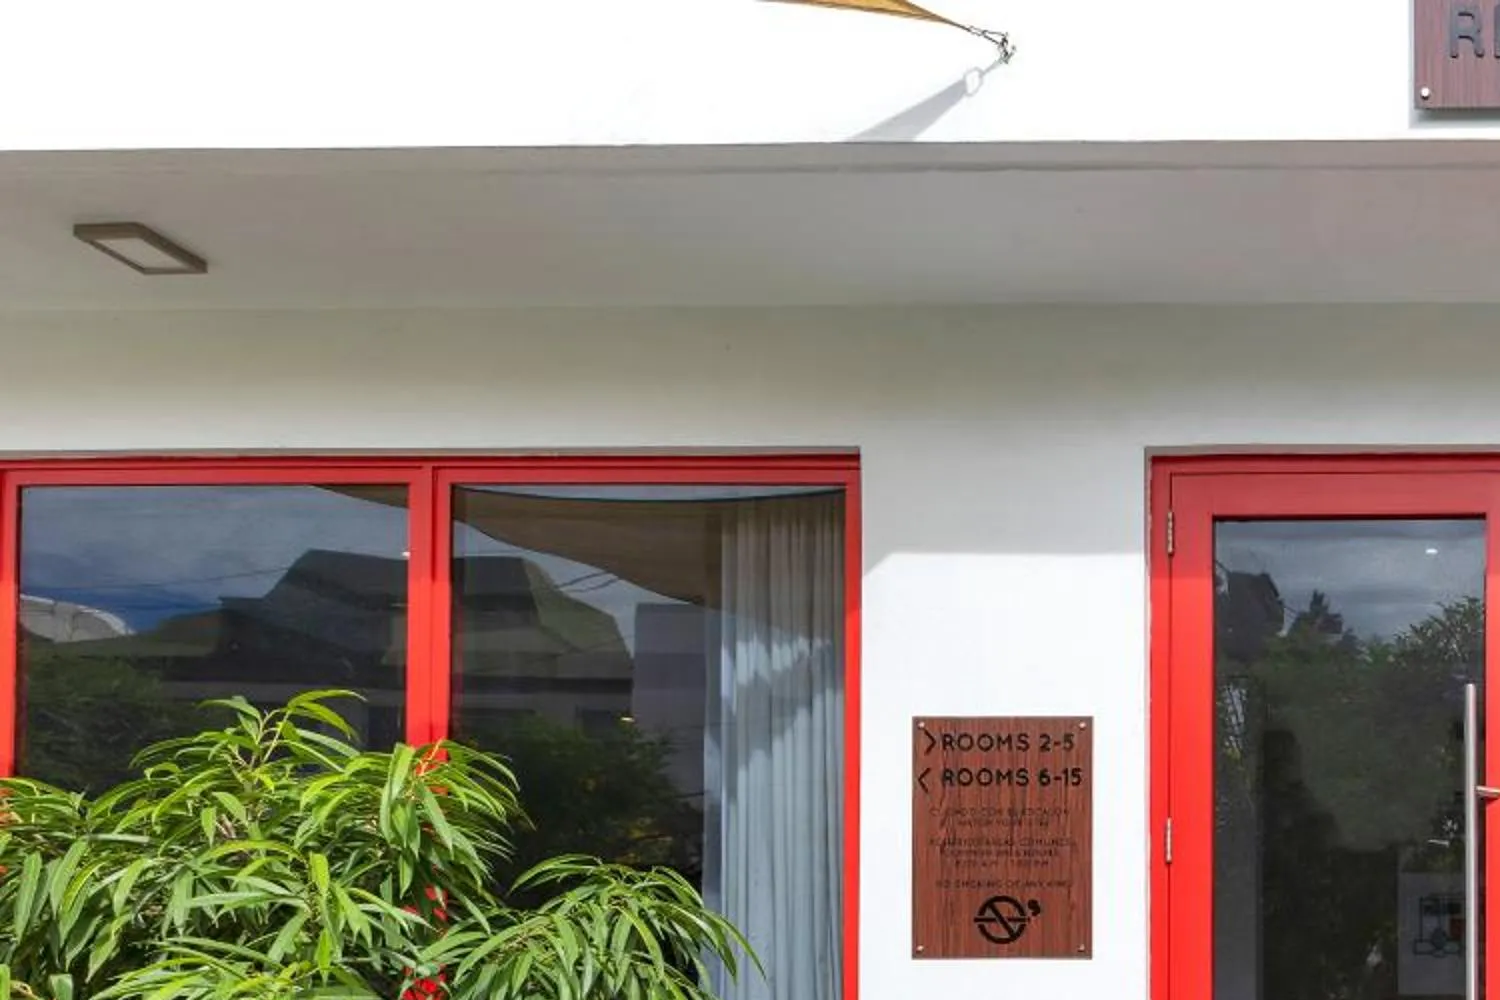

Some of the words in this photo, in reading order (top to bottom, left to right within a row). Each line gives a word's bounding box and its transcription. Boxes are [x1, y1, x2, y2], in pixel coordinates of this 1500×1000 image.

[942, 732, 1030, 752] ROOMS
[1039, 732, 1075, 752] 2-5
[942, 767, 1030, 788] ROOMS
[1037, 767, 1083, 788] 6-15
